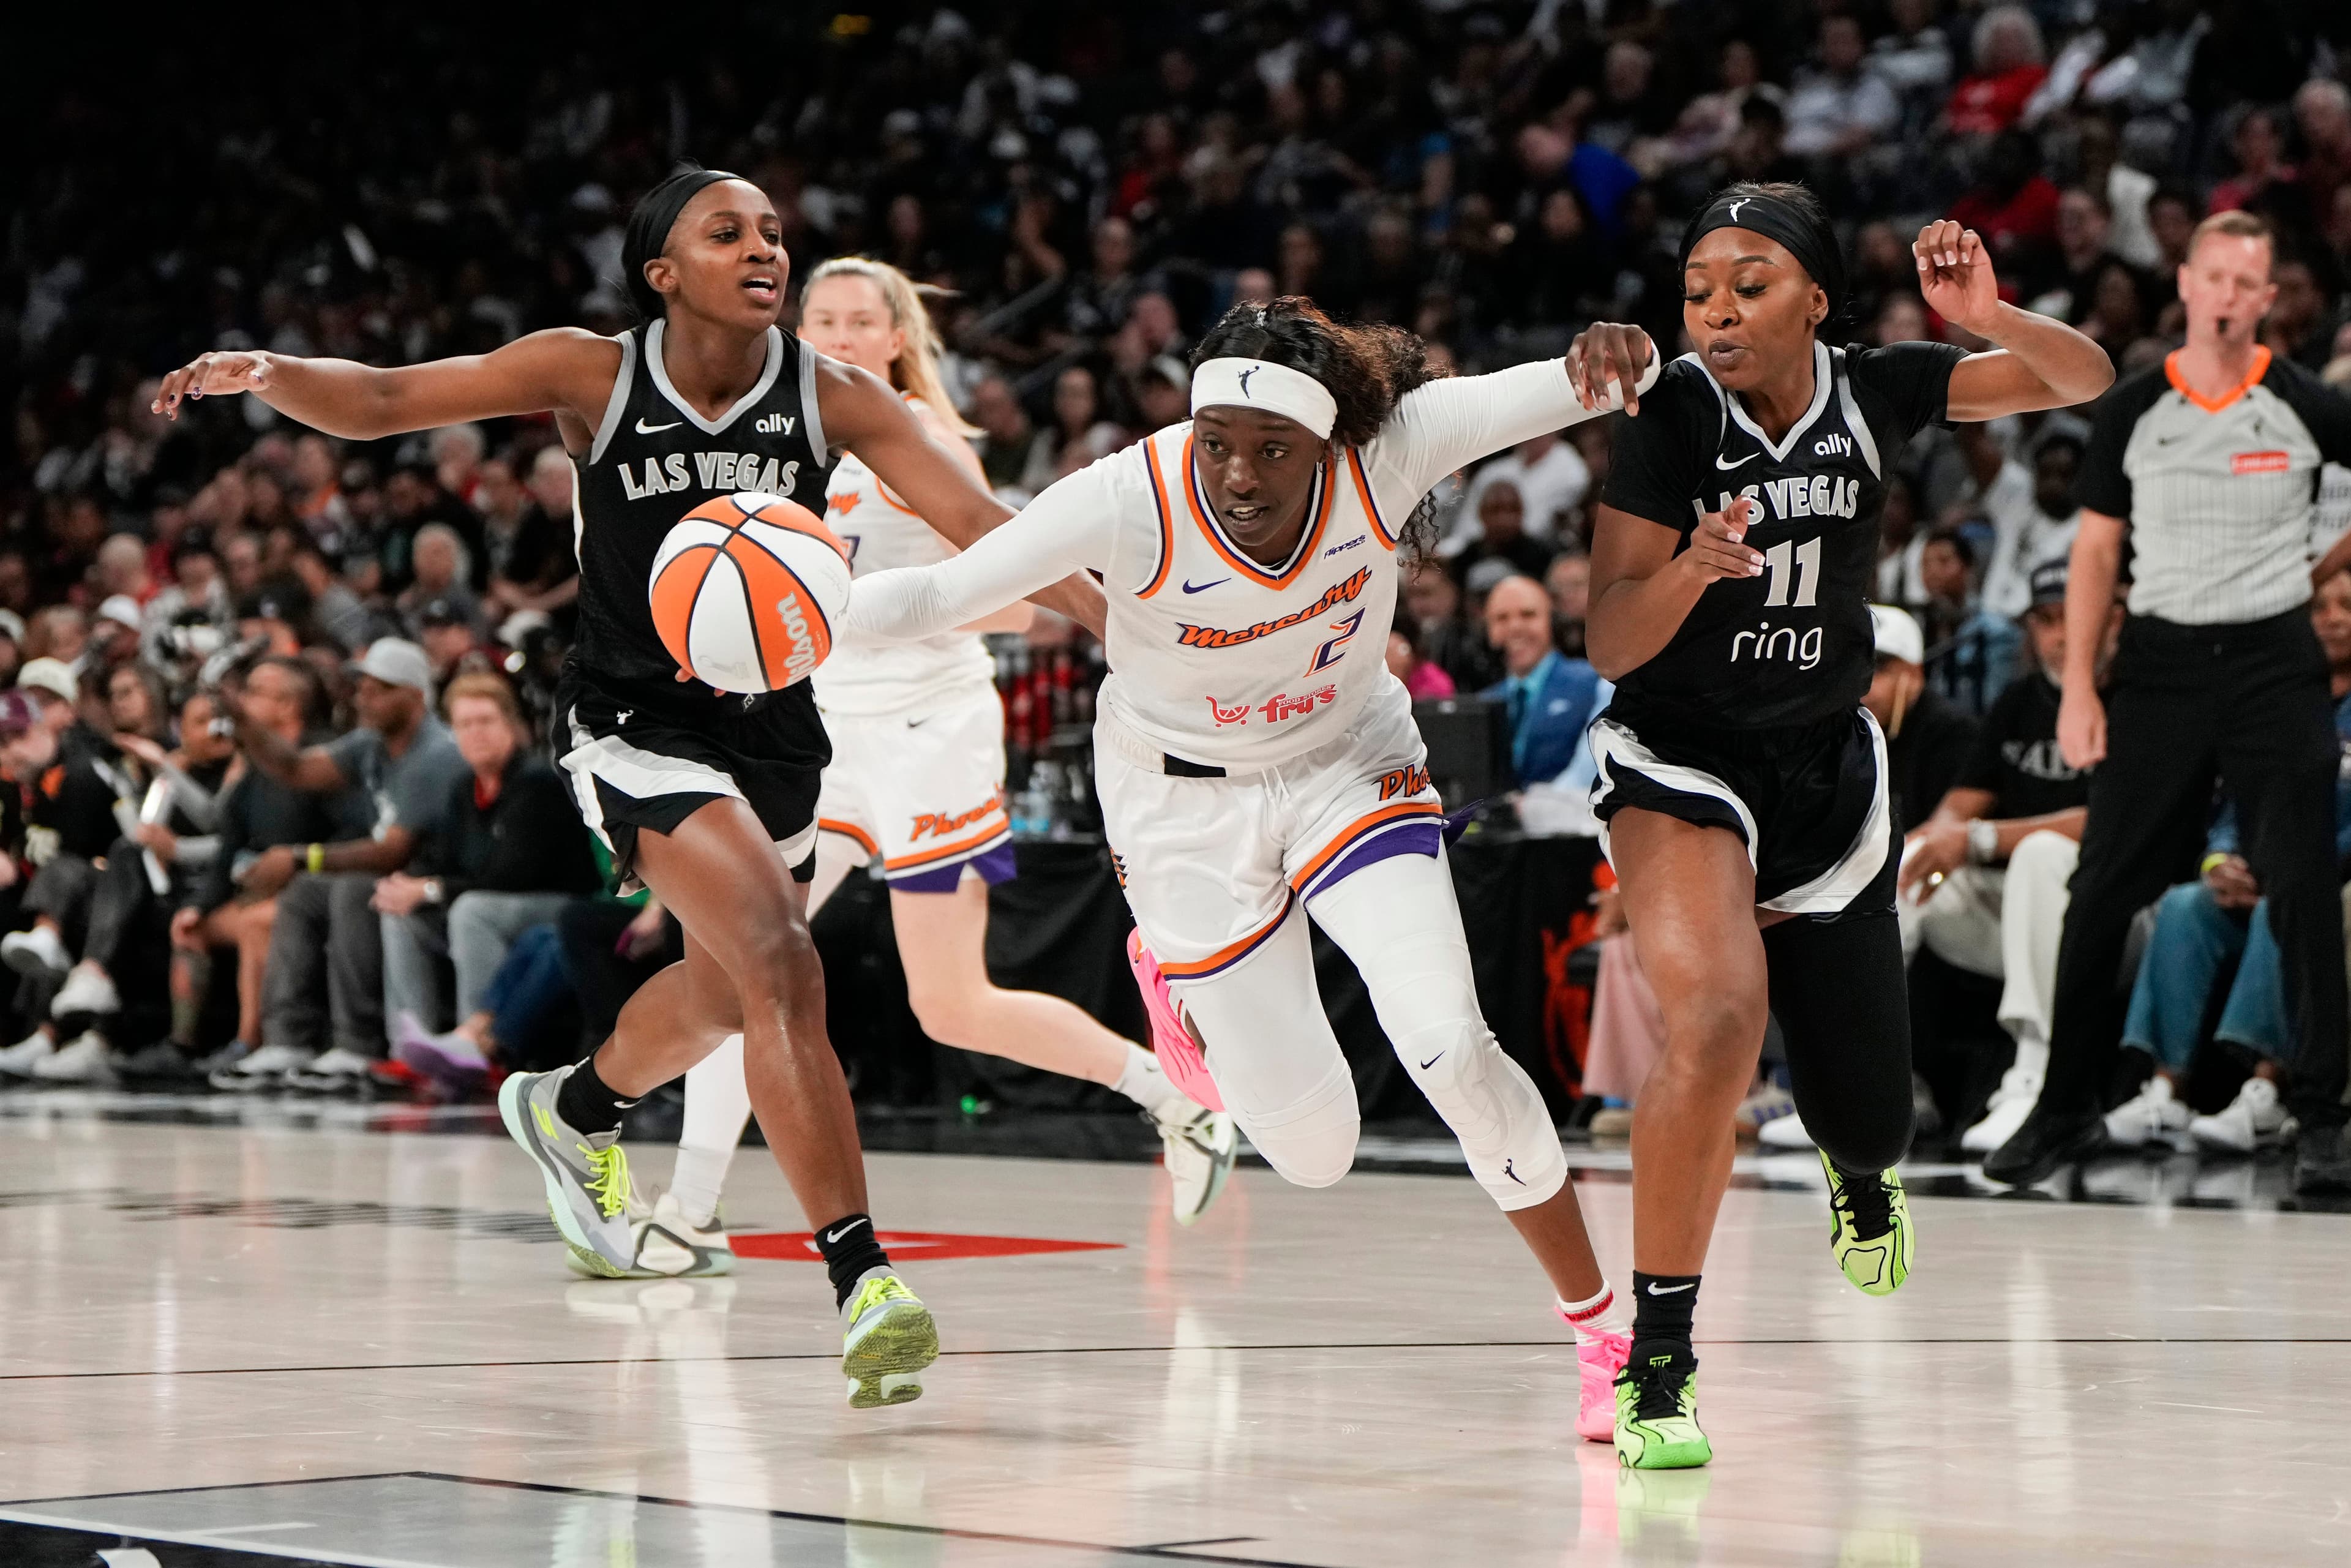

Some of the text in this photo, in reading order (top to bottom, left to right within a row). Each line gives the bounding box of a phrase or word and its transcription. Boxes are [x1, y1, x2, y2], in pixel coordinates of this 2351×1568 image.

[755, 413, 795, 435] ally
[1814, 433, 1851, 457] ally
[617, 451, 800, 501] LAS VEGAS
[1763, 475, 1859, 520] VEGAS
[1763, 536, 1821, 607] 11
[1174, 565, 1373, 649] Mercury
[1303, 604, 1366, 678] 2
[1730, 621, 1823, 670] ring
[1277, 685, 1332, 707] FOOD STORES
